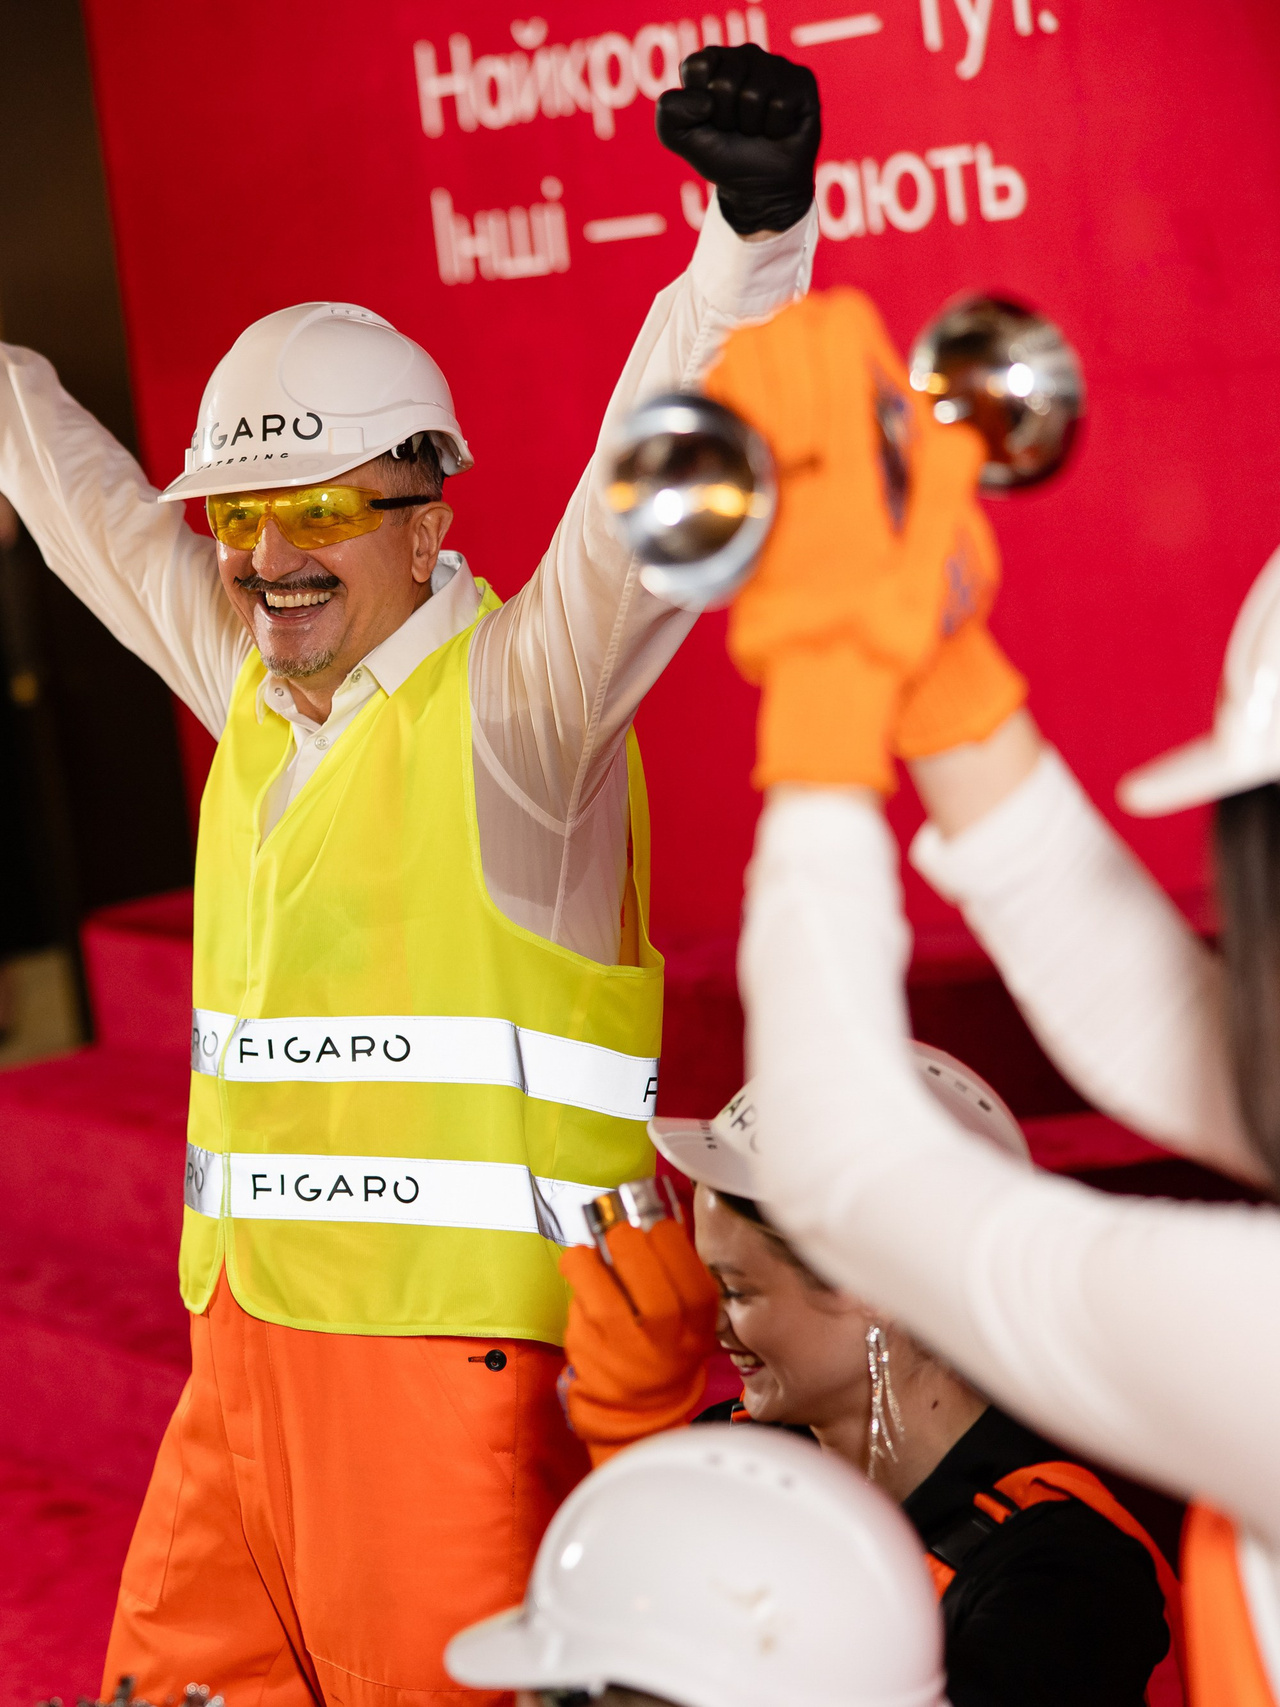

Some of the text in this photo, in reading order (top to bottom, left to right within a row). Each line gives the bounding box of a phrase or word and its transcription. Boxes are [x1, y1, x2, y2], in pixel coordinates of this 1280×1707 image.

[791, 14, 884, 48] —
[430, 142, 1028, 285] Інші — ають
[238, 1034, 411, 1064] FIGARO
[252, 1173, 419, 1204] FIGARO
